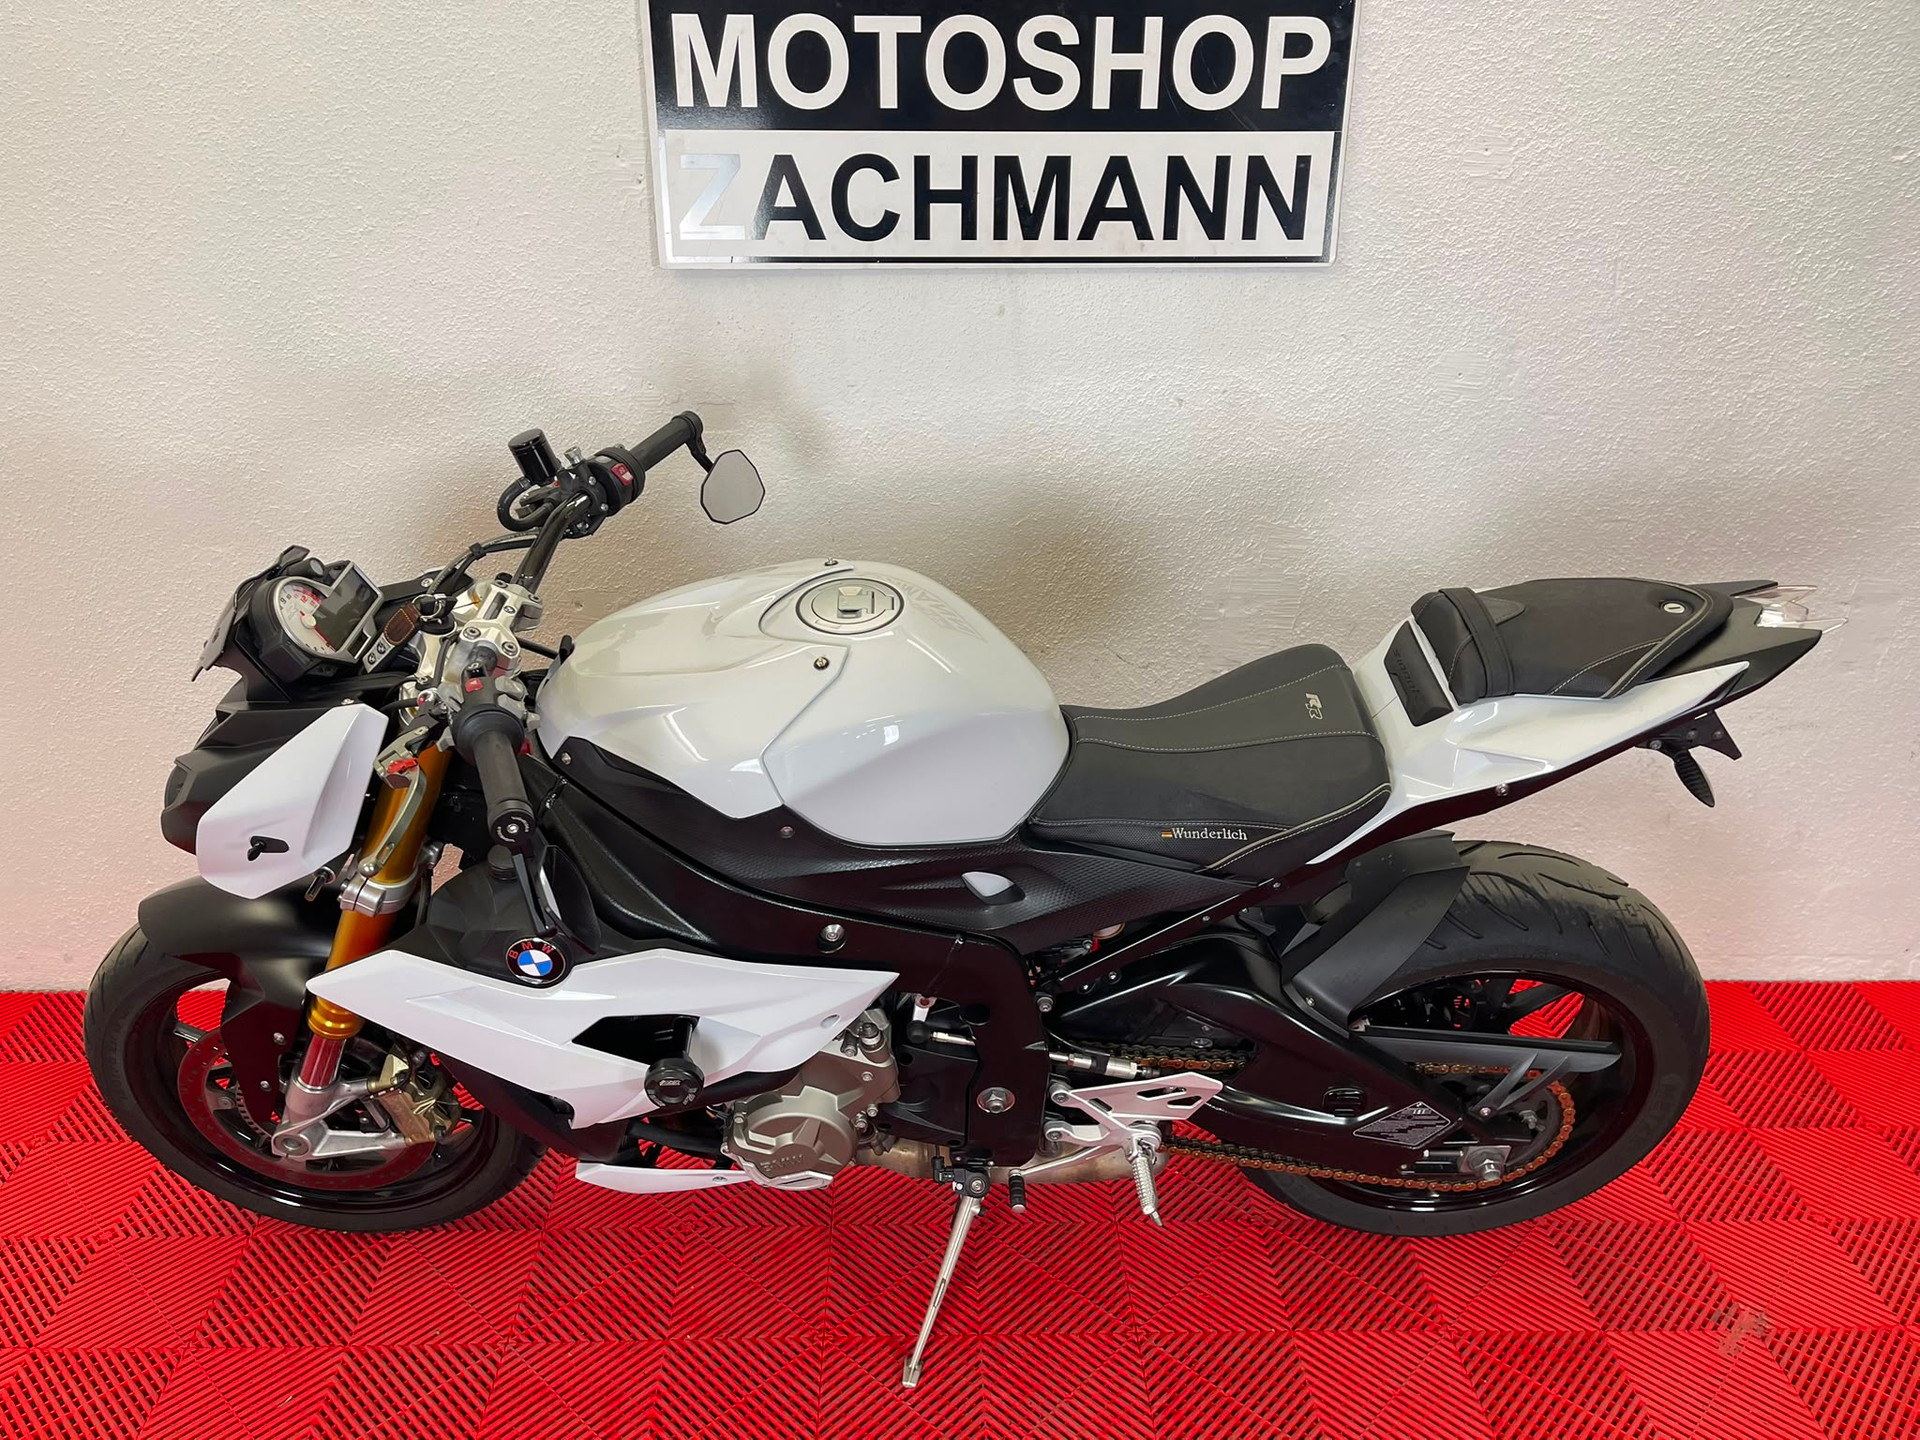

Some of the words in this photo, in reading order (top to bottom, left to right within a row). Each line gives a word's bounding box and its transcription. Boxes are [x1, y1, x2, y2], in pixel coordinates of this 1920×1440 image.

[670, 12, 1332, 111] MOTOSHOP
[679, 153, 1313, 241] ZACHMANN
[1171, 827, 1248, 841] Wunderlich
[508, 941, 554, 959] BMW
